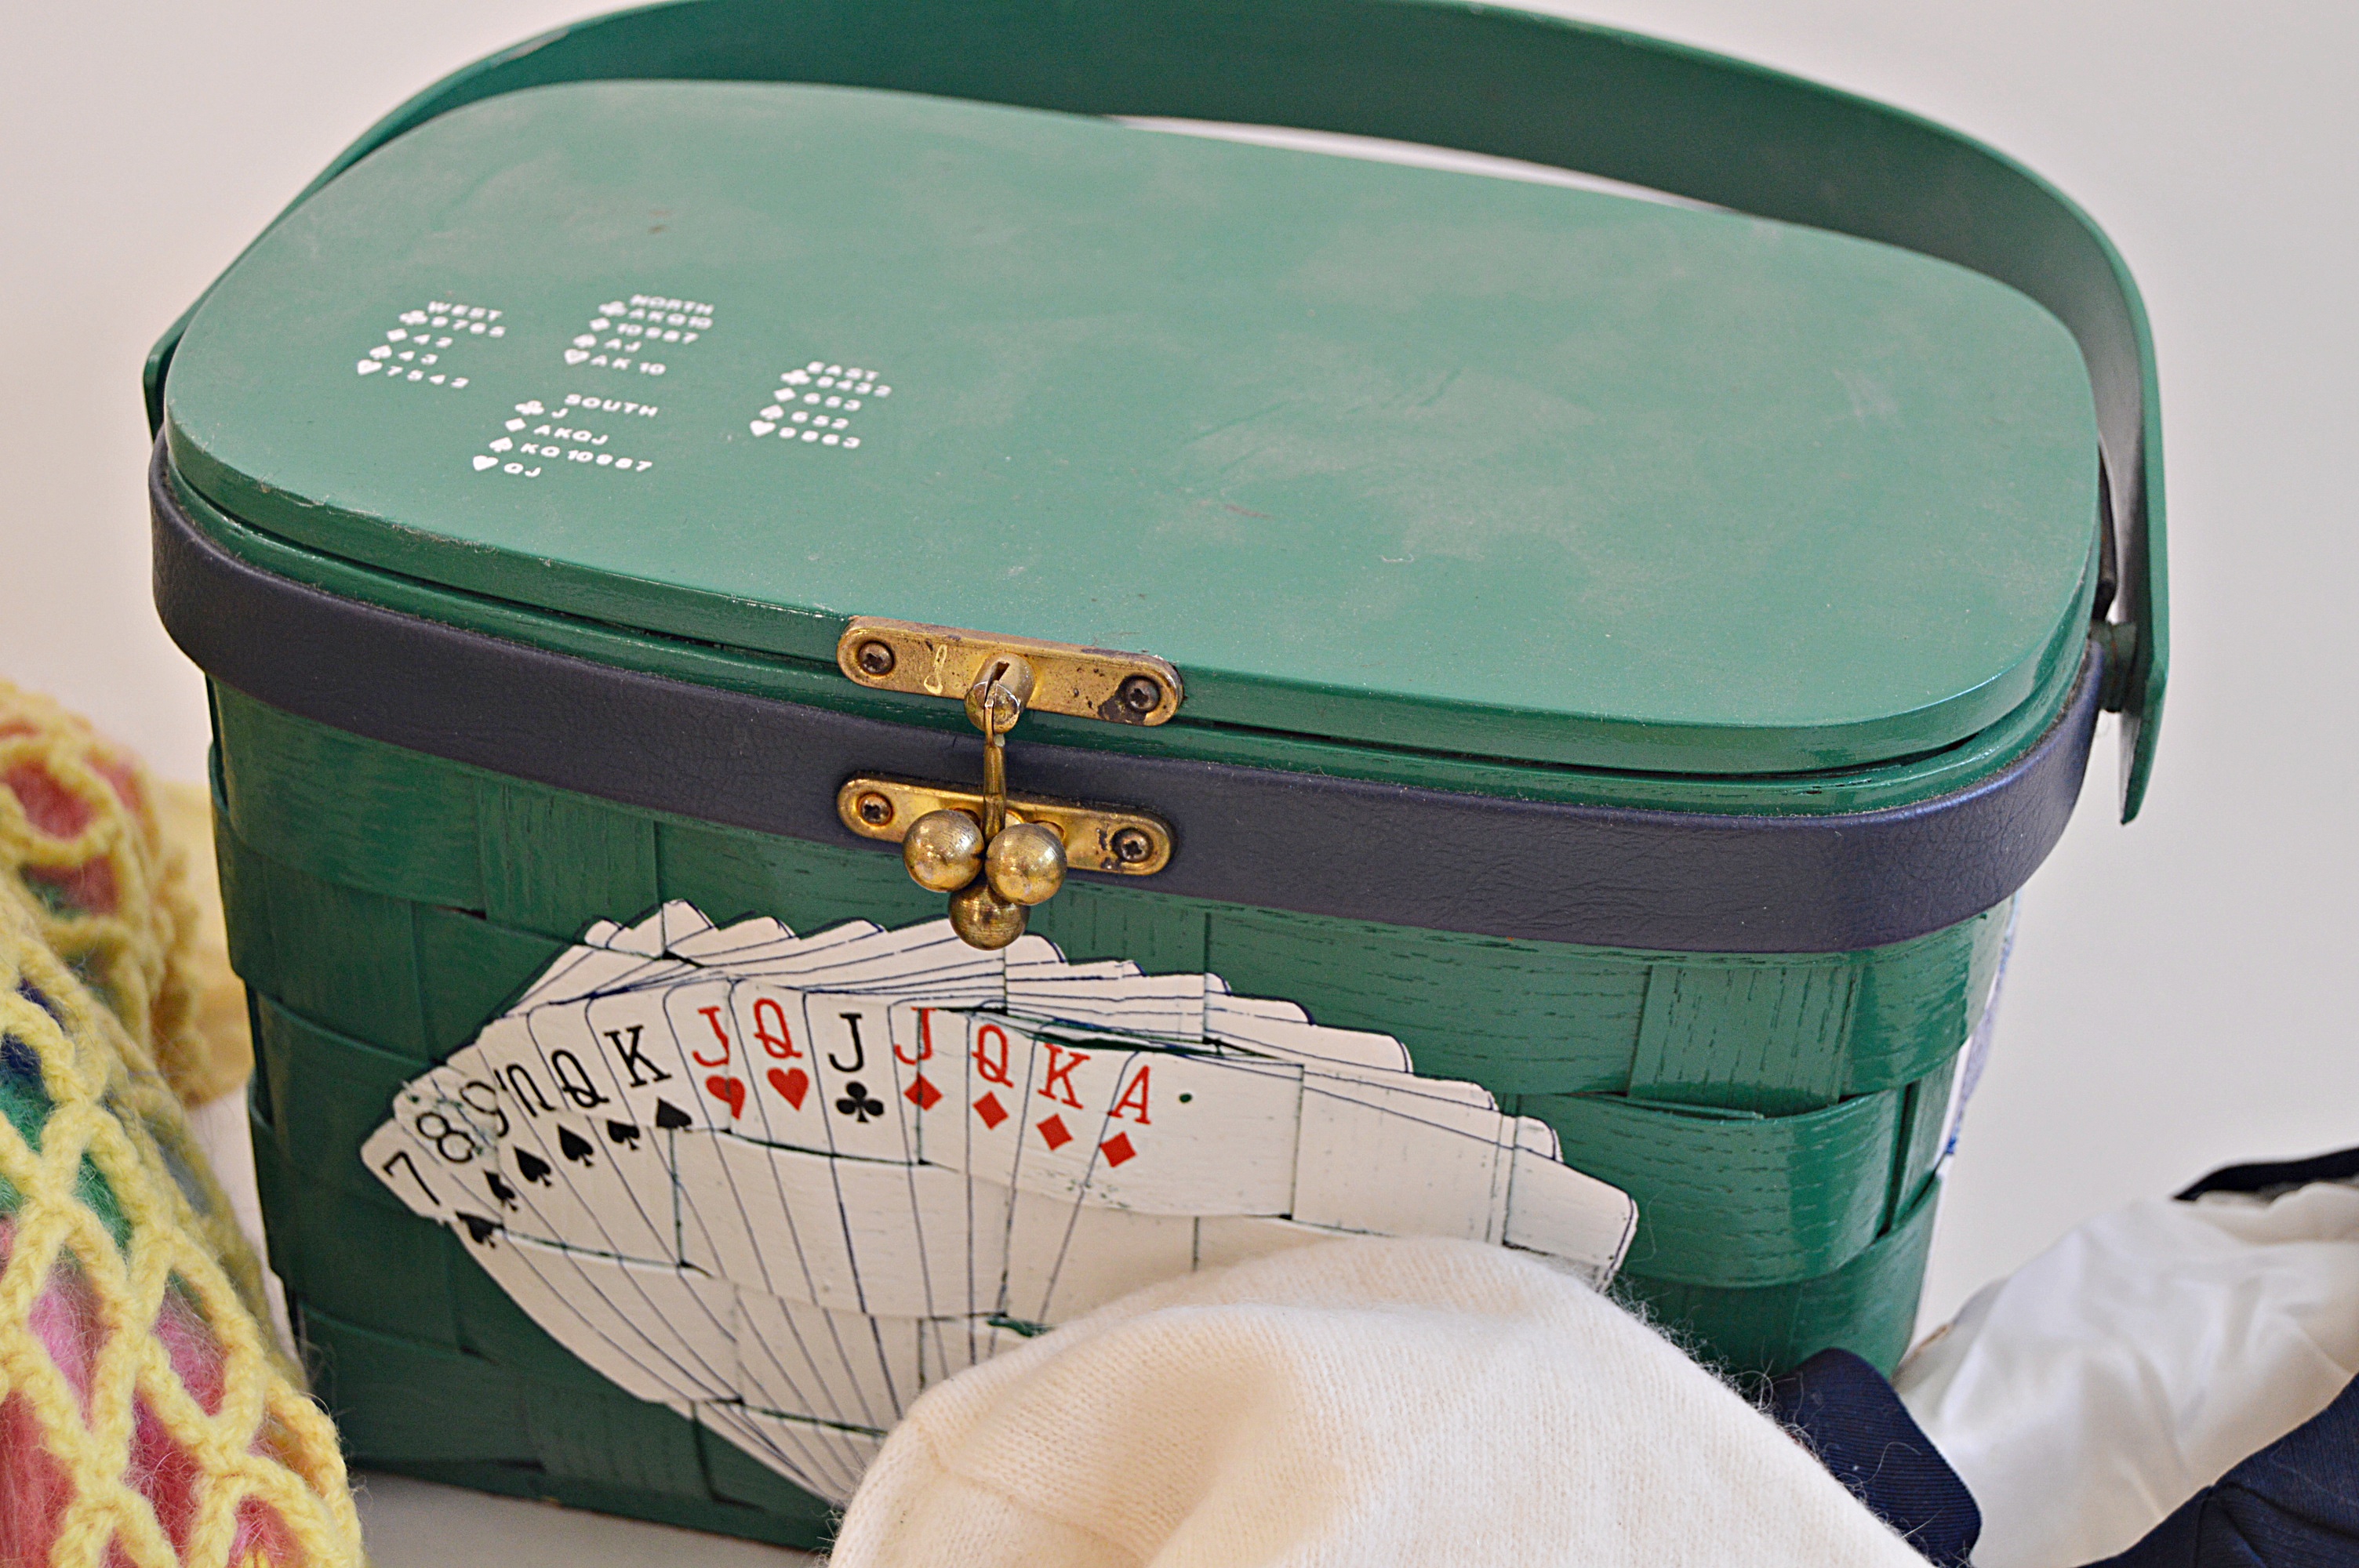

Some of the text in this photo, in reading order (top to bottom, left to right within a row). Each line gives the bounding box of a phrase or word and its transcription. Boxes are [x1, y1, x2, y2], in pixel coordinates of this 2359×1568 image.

[630, 294, 714, 315] NORTH
[551, 408, 569, 419] J
[564, 394, 659, 417] SOUTH
[383, 1150, 441, 1206] 7
[415, 1111, 477, 1164] 8
[460, 1080, 510, 1138] 9
[551, 1049, 611, 1109] Q
[603, 1024, 673, 1088] K
[692, 1006, 730, 1067] J
[753, 997, 804, 1059] Q
[828, 1013, 863, 1073] J
[894, 1007, 936, 1065] J
[971, 1023, 1014, 1088] Q
[1038, 1043, 1090, 1109] K
[1107, 1065, 1151, 1124] A
